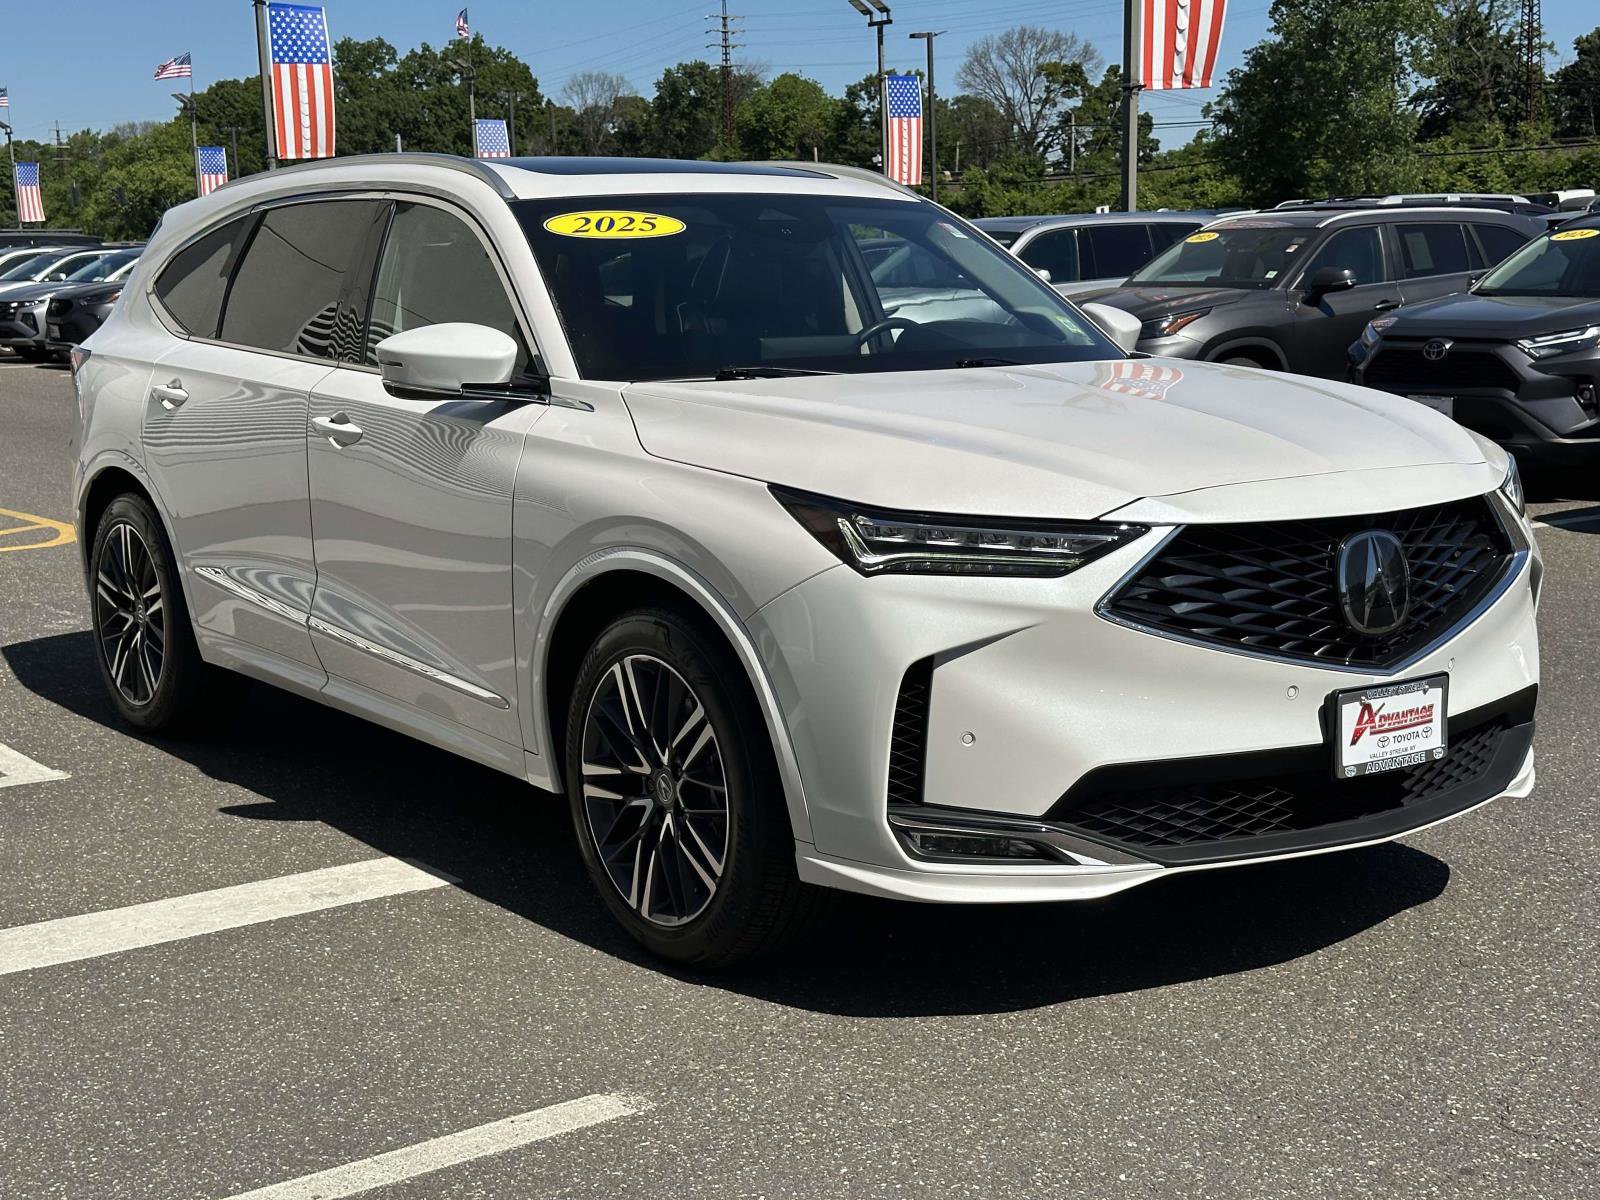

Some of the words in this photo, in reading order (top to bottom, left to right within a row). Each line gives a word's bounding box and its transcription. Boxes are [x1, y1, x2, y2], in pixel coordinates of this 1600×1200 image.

[571, 215, 658, 233] 2025
[1366, 686, 1398, 700] VALLEY
[1392, 730, 1420, 744] TOYOTA
[1369, 751, 1388, 759] VALLEY
[1365, 752, 1426, 774] ADVANTAGE
